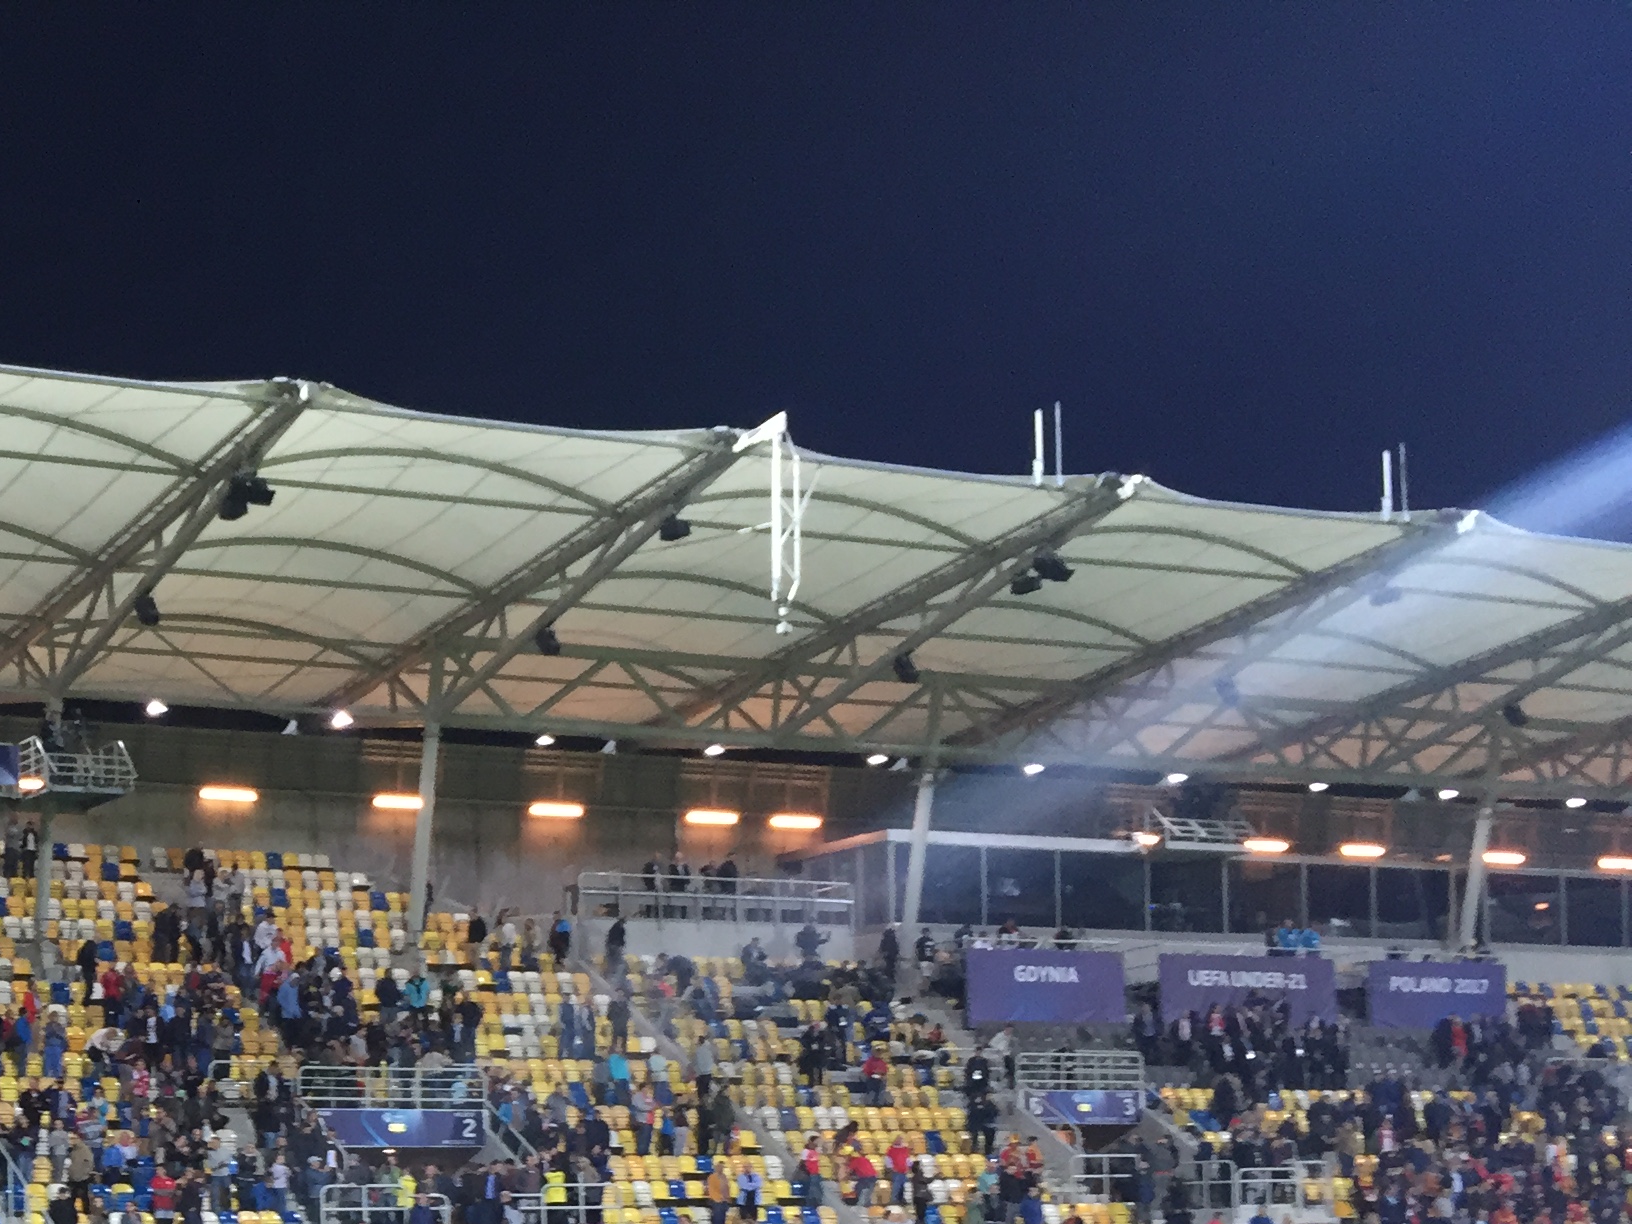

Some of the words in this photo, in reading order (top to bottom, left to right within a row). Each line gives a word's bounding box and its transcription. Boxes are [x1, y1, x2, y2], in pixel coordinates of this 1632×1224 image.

[1013, 965, 1080, 983] GDYNIA
[1389, 976, 1452, 993] POLAND
[1122, 1098, 1137, 1116] 3
[461, 1118, 478, 1138] 2
